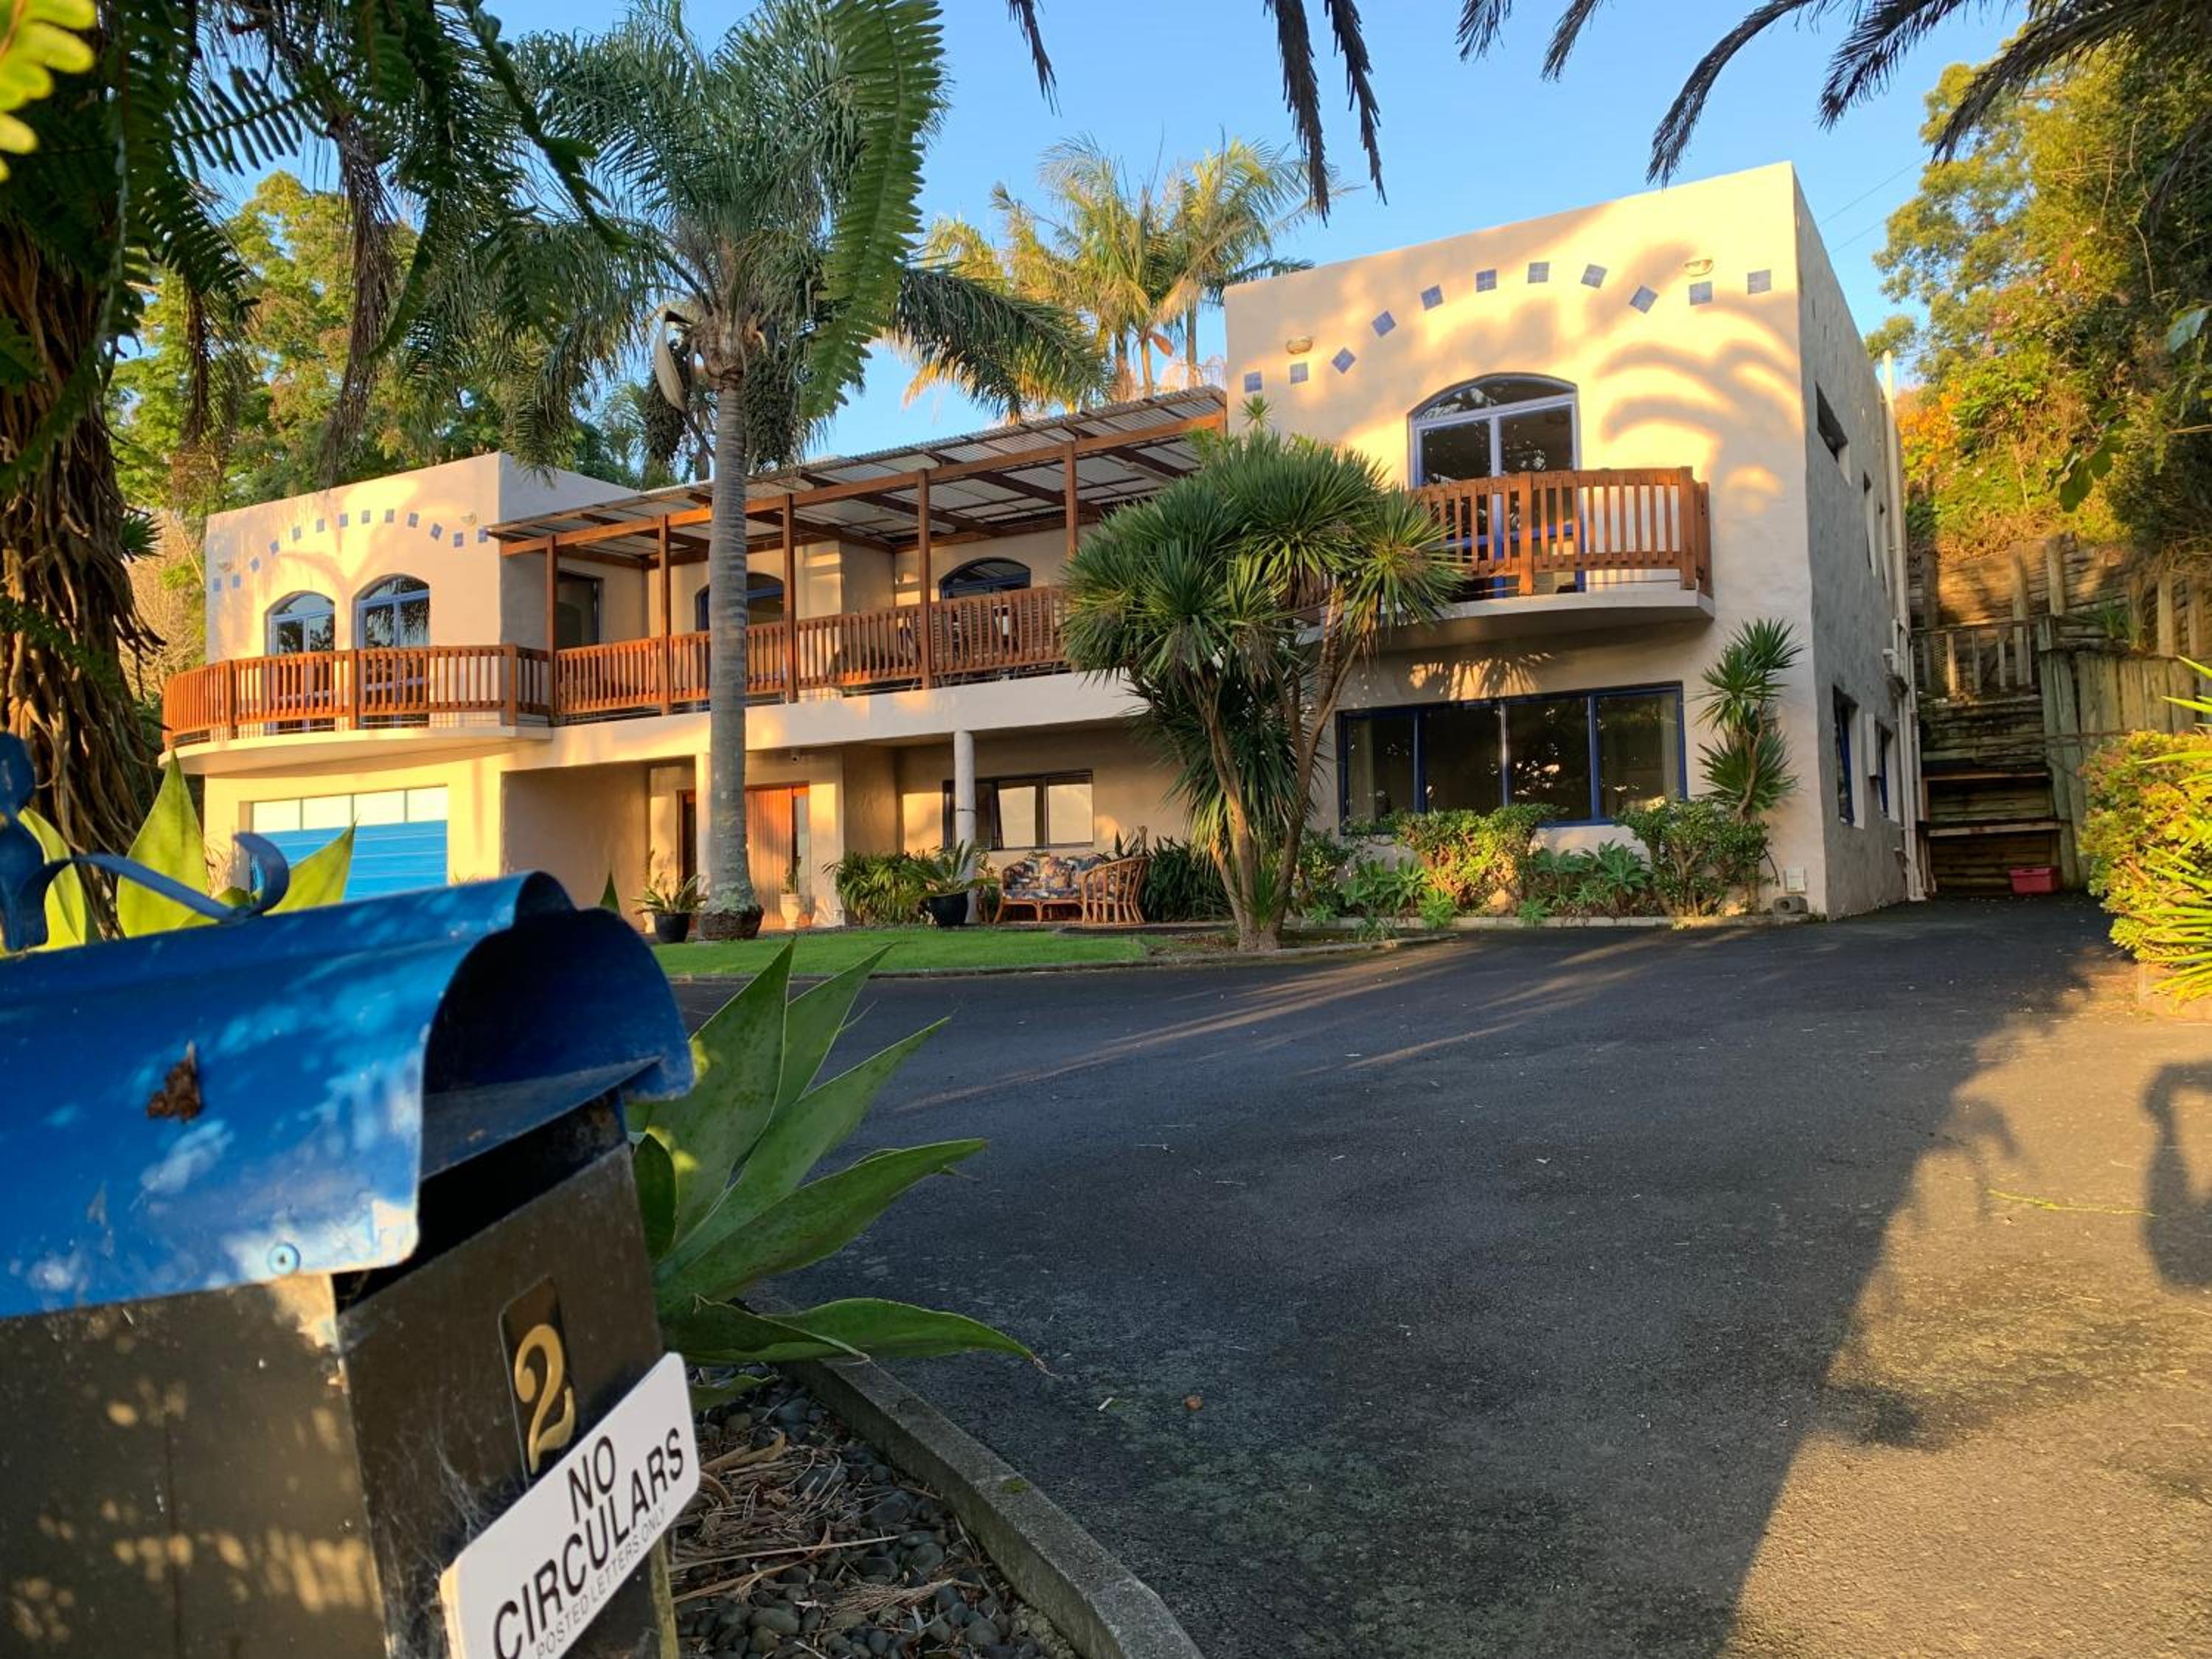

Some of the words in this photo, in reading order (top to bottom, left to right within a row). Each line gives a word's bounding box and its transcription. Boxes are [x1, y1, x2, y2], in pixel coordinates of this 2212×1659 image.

[515, 1324, 575, 1474] 2
[493, 1427, 684, 1659] CIRCULARS
[567, 1436, 616, 1524] NO
[536, 1593, 589, 1659] POSTED
[591, 1534, 640, 1604] LETTERS
[641, 1506, 667, 1543] ONLY
